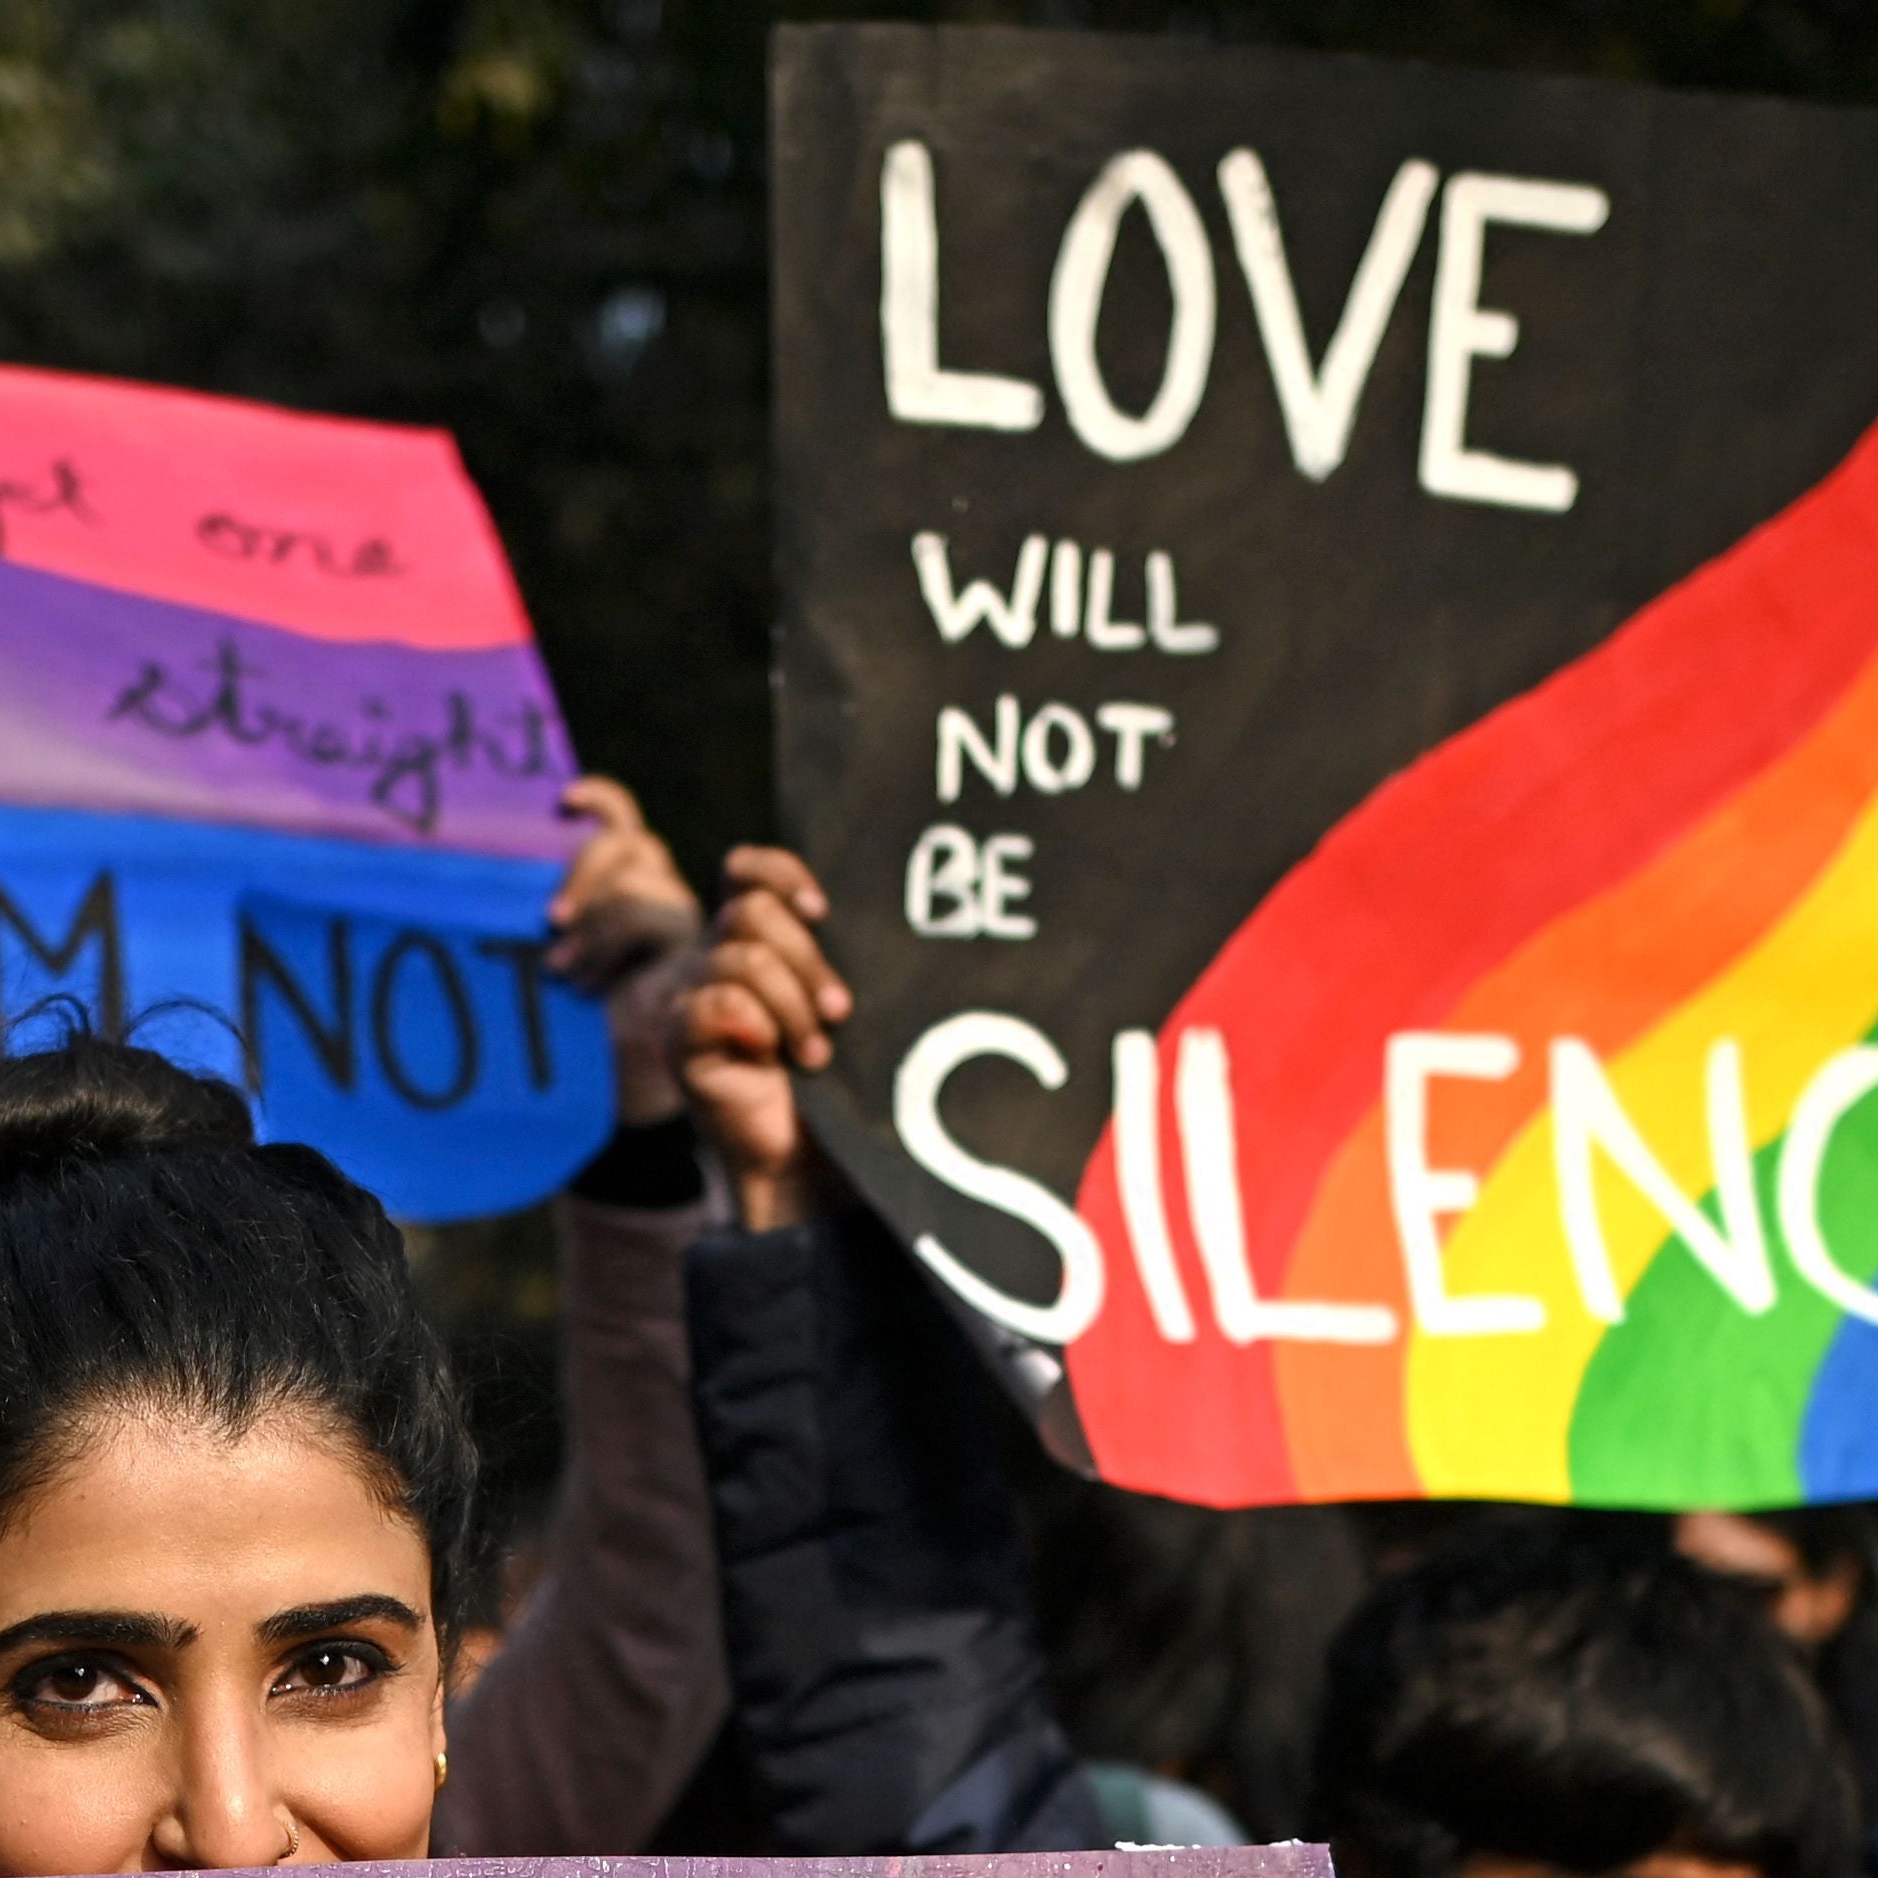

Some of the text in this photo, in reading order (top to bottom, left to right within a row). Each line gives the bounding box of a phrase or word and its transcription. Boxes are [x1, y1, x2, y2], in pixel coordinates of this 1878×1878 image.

[879, 138, 1610, 511] LOVE
[195, 511, 410, 580] one
[912, 532, 1218, 652] WILL
[104, 632, 562, 836] straight
[936, 694, 1174, 802] NOT
[904, 824, 1036, 938] BE
[236, 908, 554, 1113] NOT
